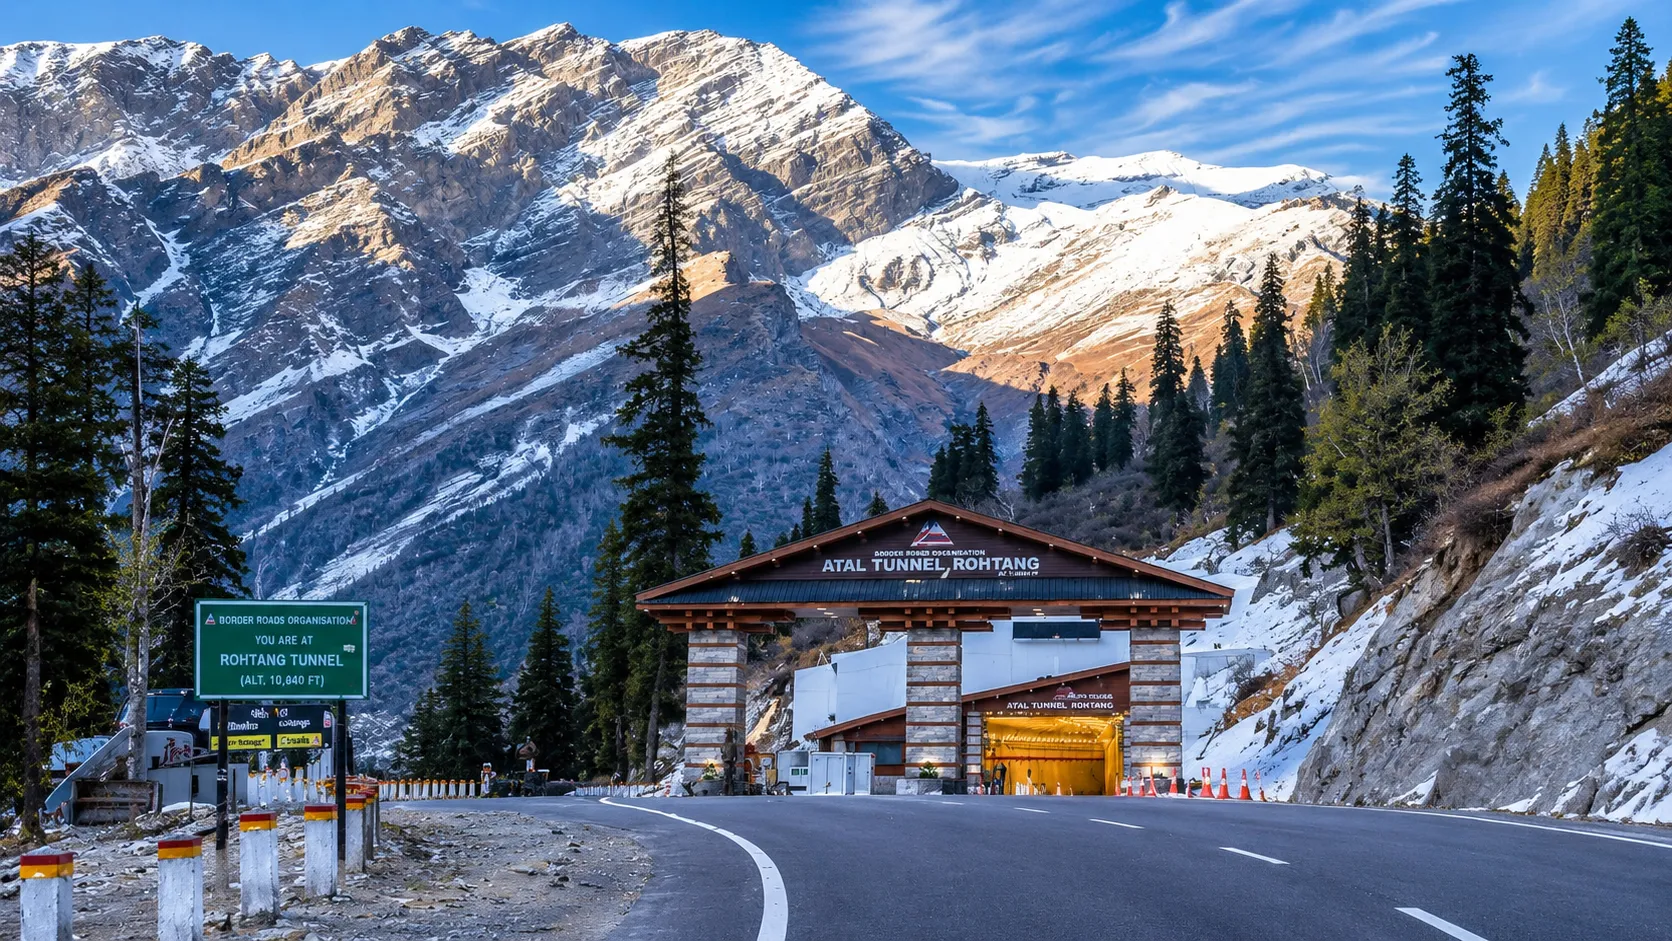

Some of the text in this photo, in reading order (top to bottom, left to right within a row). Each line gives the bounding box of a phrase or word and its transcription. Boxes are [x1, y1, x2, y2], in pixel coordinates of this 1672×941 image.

[822, 559, 867, 572] ATAL
[953, 557, 1040, 571] ROHTANG
[219, 615, 353, 625] BORDER ROADS ORGANISATION
[255, 635, 313, 645] YOU ARE AT
[220, 653, 344, 667] ROHTANG TUNNEL
[308, 675, 325, 688] FT)
